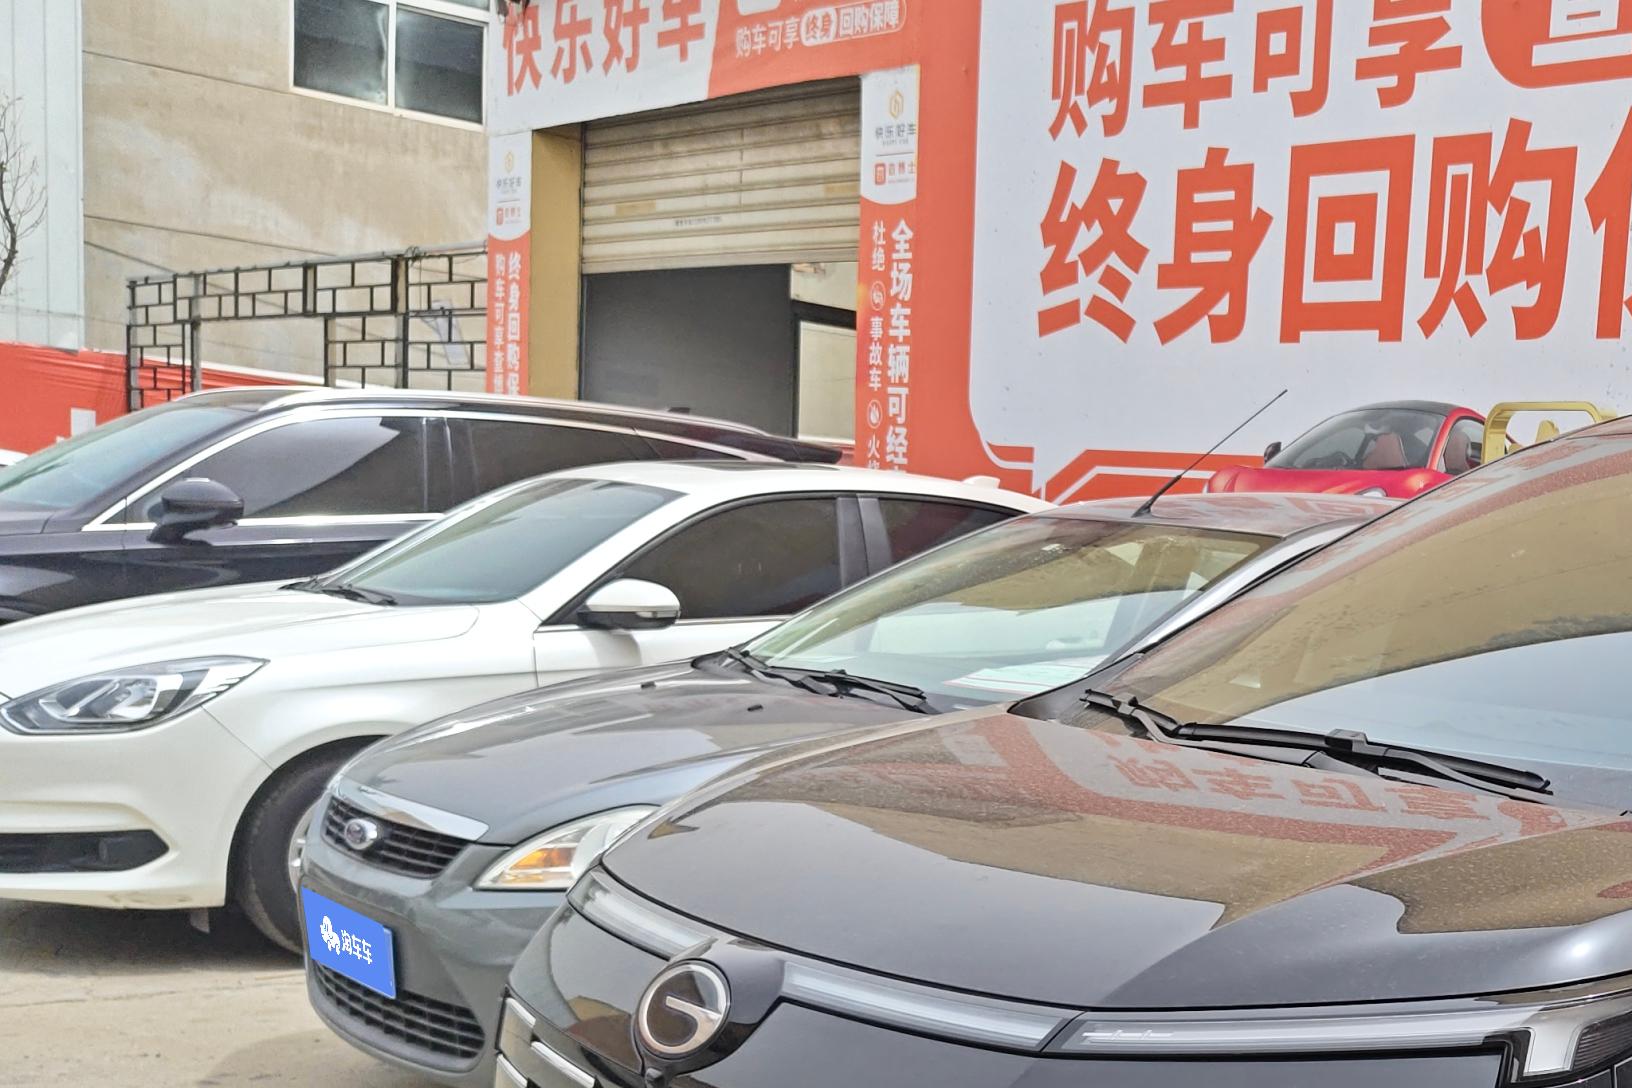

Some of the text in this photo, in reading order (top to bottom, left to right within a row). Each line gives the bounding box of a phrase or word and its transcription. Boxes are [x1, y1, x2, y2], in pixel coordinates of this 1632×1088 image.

[502, 0, 706, 97] 快乐好车
[872, 220, 886, 272] 杜绝
[868, 316, 884, 392] 事故车
[886, 219, 913, 470] 全场车辆可经
